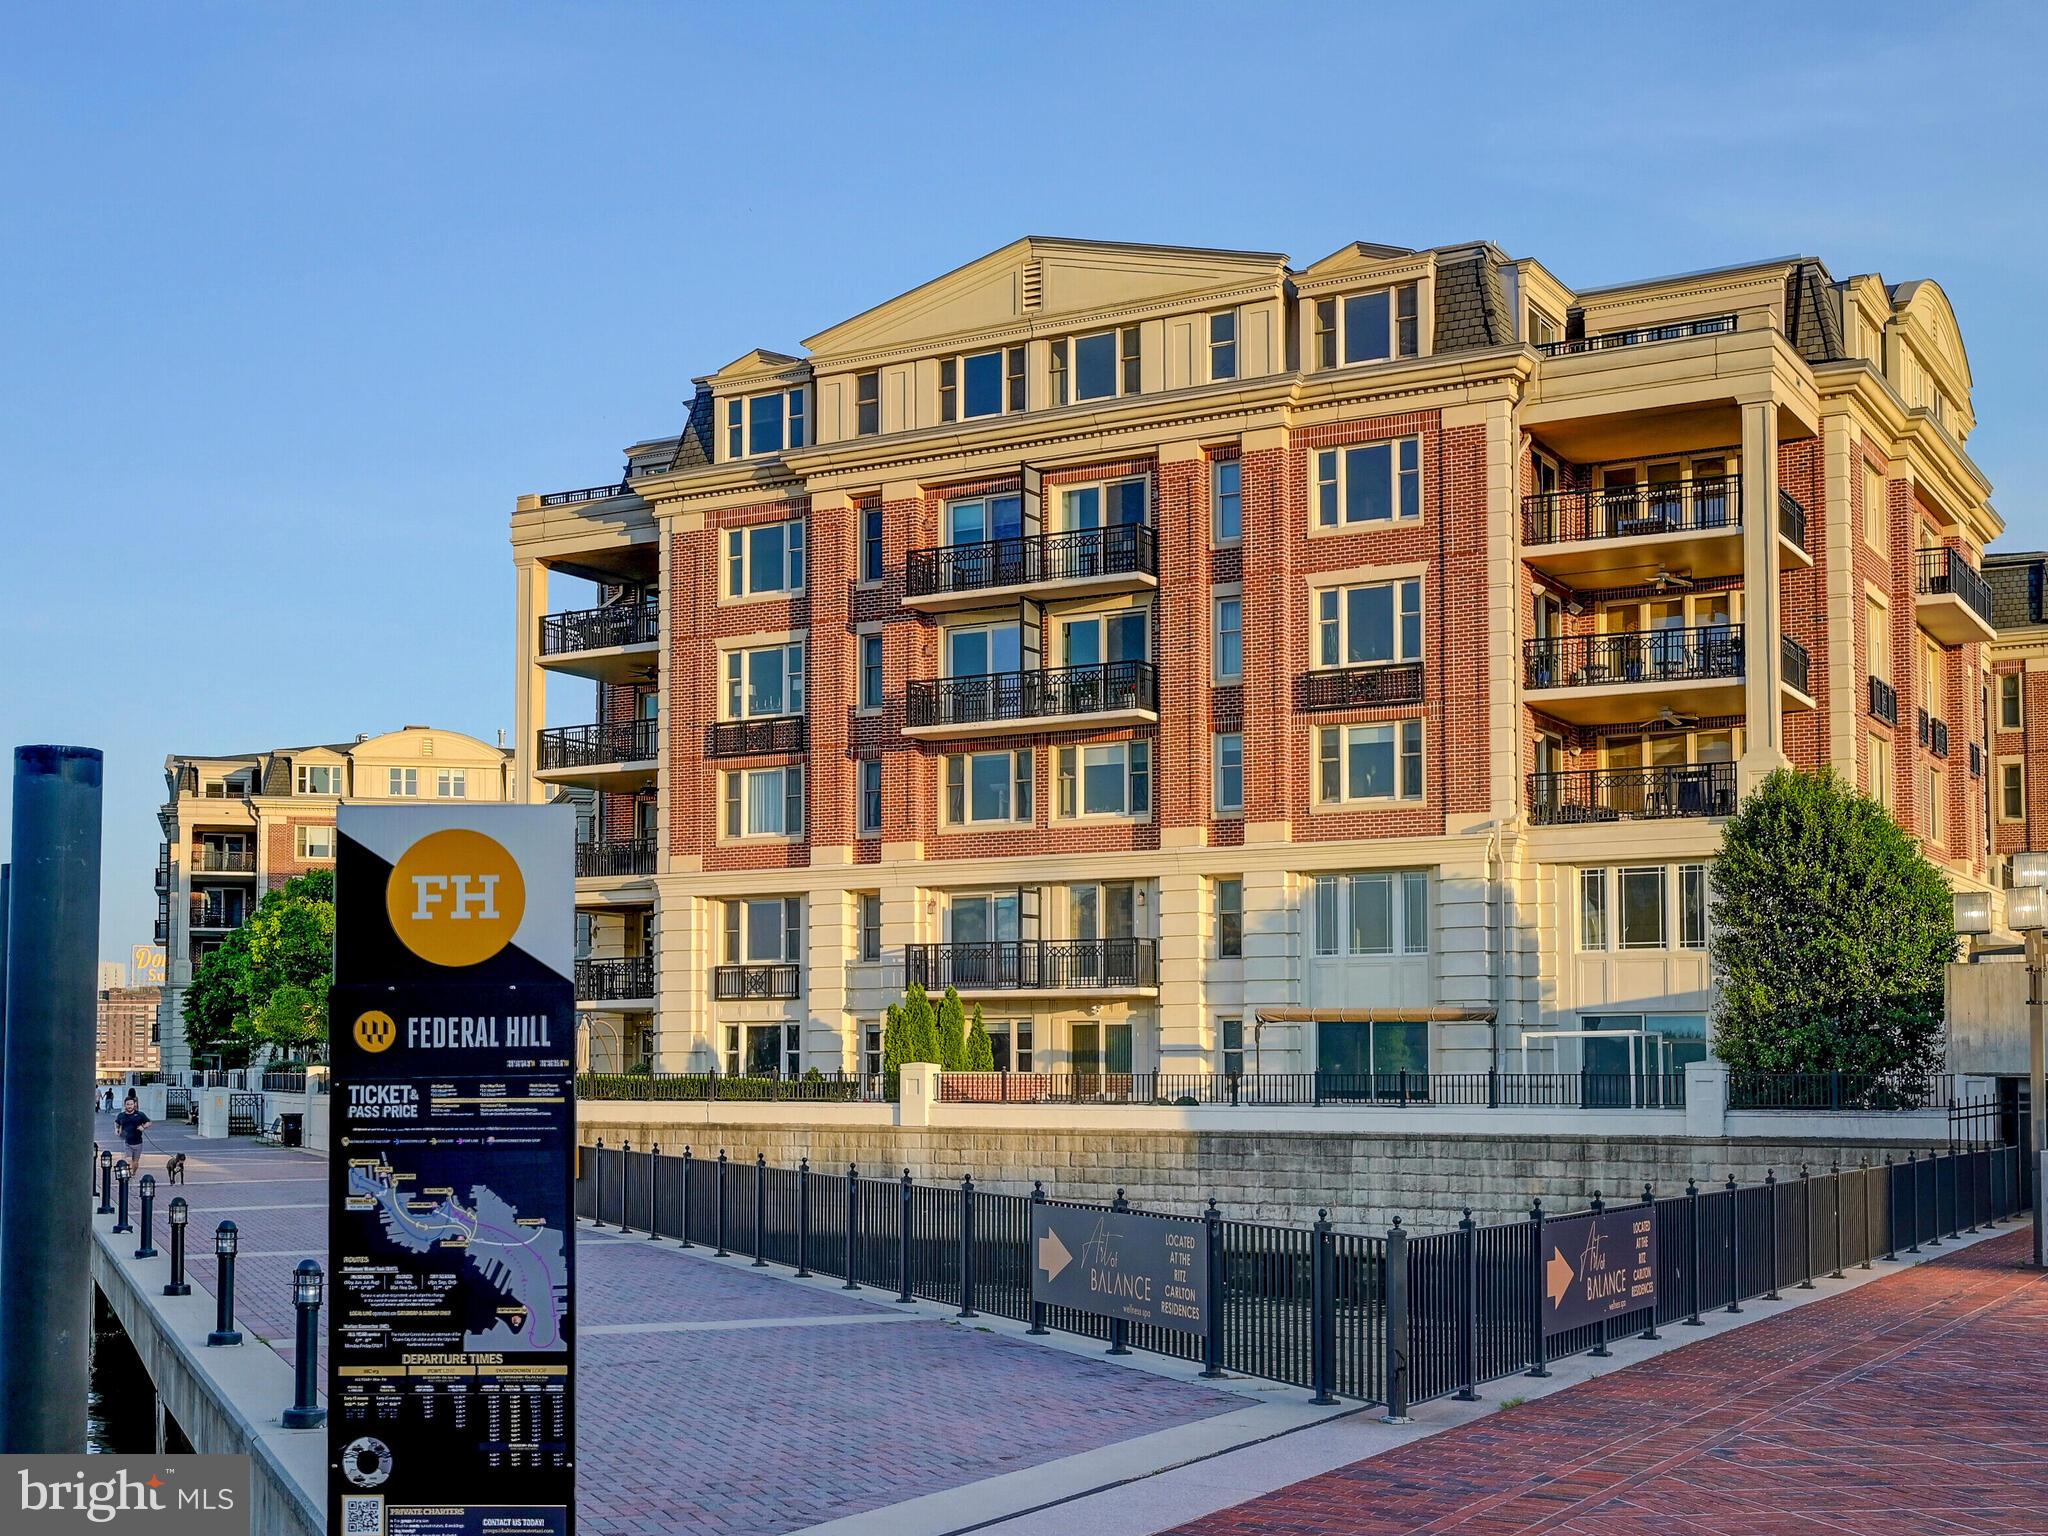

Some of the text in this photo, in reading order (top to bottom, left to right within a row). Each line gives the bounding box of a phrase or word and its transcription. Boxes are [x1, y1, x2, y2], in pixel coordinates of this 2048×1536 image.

[412, 875, 500, 920] FH
[408, 1015, 551, 1049] FEDERAL HILL
[347, 1105, 381, 1119] PASS
[382, 1104, 418, 1119] PRICE
[1632, 1220, 1651, 1234] LOCATED
[1080, 1216, 1124, 1270] Art of
[1165, 1233, 1195, 1250] LOCATED
[1169, 1252, 1191, 1266] AT THE
[1173, 1269, 1187, 1283] RITZ
[1633, 1266, 1652, 1281] CARLTON
[1090, 1268, 1151, 1301] BALANCE
[1587, 1269, 1627, 1301] BALANCE
[1631, 1282, 1654, 1298] RESIDENCES
[1164, 1284, 1196, 1302] CARLTON
[1122, 1303, 1151, 1319] wellness spa
[1160, 1301, 1200, 1321] RESIDENCES
[402, 1353, 504, 1365] DEPARTURE TIMES
[389, 1508, 423, 1516] PRIVATE
[482, 1518, 545, 1527] CONTACT US TODAY!
